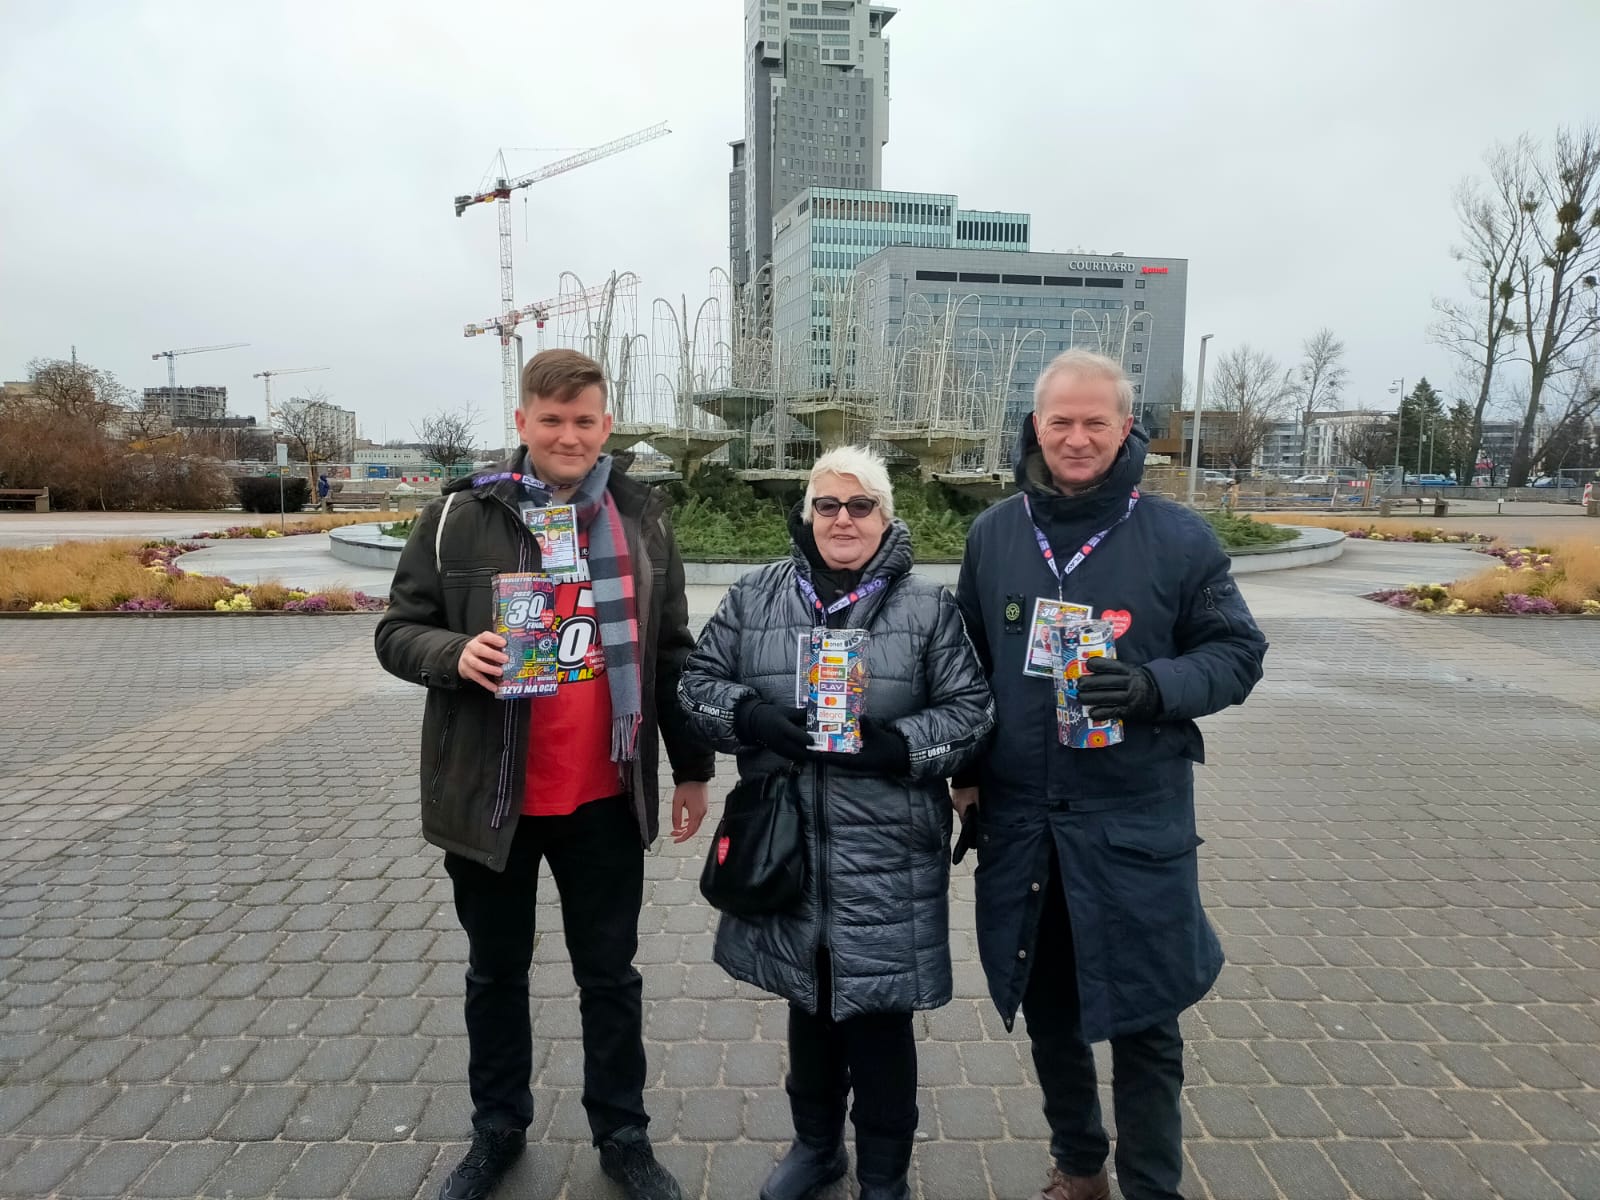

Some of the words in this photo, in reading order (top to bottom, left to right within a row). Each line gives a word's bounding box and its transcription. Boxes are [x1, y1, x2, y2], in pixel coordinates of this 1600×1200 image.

[1069, 261, 1136, 273] COURTYARD
[506, 592, 547, 626] 30
[524, 684, 537, 693] NA
[539, 683, 558, 693] OCZY
[821, 683, 843, 691] PLAY
